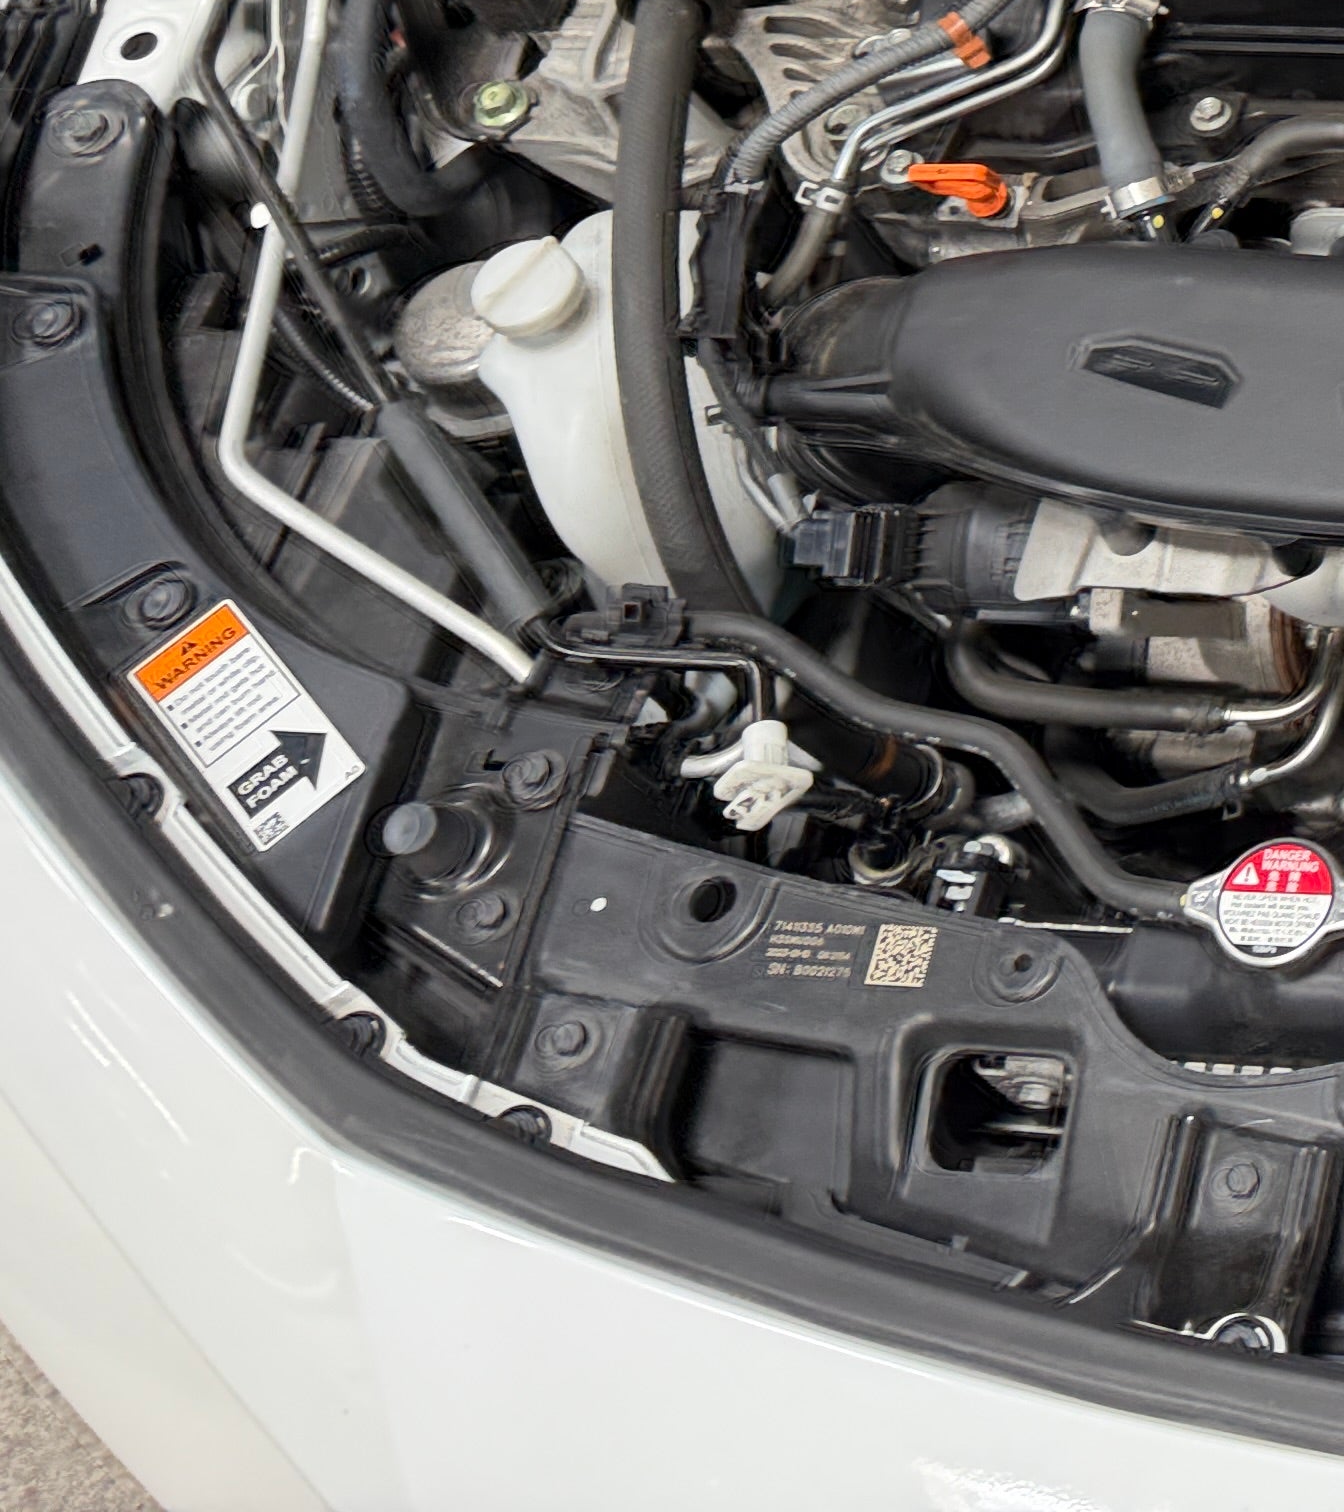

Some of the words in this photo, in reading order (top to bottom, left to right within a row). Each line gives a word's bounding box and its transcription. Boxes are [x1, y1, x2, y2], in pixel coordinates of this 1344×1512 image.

[153, 627, 237, 690] WARNING
[238, 755, 288, 795] GRAB
[246, 766, 298, 808] FOAM
[1263, 849, 1312, 861] DANGER
